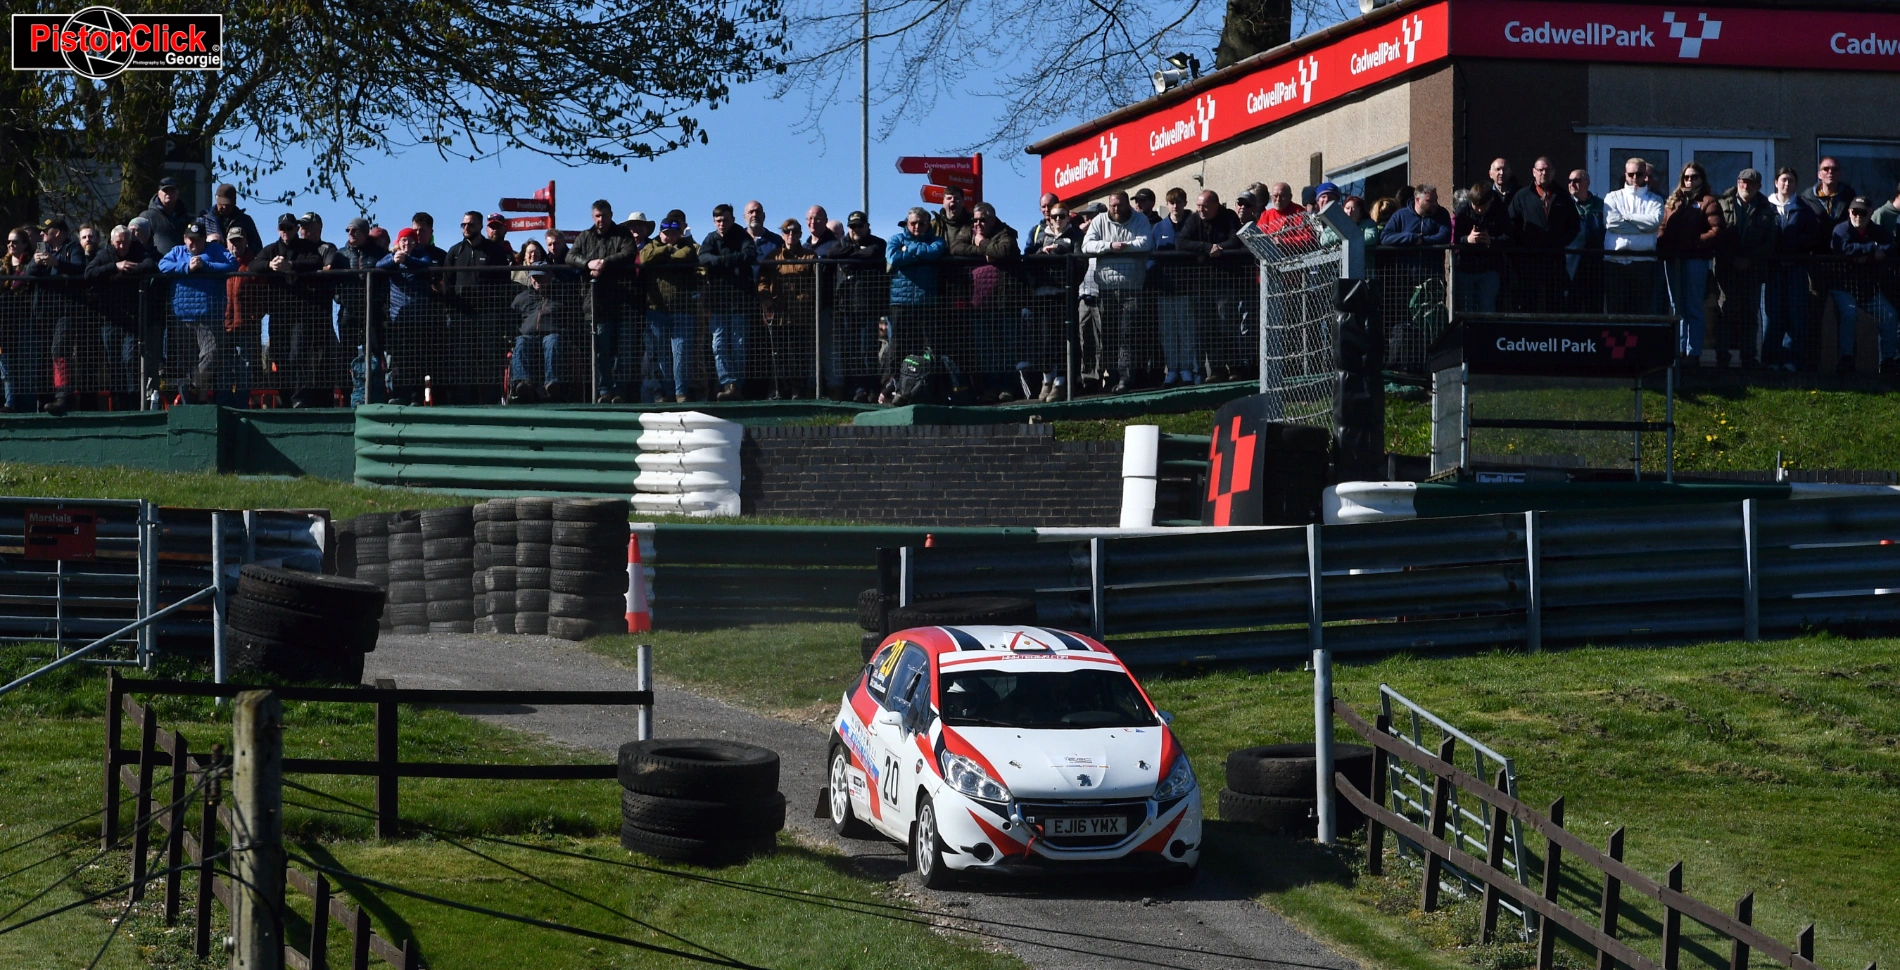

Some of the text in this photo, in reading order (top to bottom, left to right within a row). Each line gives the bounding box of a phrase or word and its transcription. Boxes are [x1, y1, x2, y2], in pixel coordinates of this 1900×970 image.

[1504, 20, 1655, 48] CadwellPark
[1830, 31, 1900, 56] Cadw
[1350, 37, 1401, 75] CadwellPark
[1246, 77, 1298, 114] CadwellPark
[1149, 115, 1196, 152] CadwellPark
[924, 162, 956, 170] Donington
[1054, 152, 1099, 188] CadwellPark
[516, 202, 547, 210] Footbridge
[511, 219, 546, 228] Hall Bends
[1496, 336, 1597, 353] Cadwell Park
[29, 513, 72, 523] Marshals
[880, 639, 905, 677] 20
[883, 755, 899, 805] 20
[1054, 818, 1119, 834] EJ16 YMX
